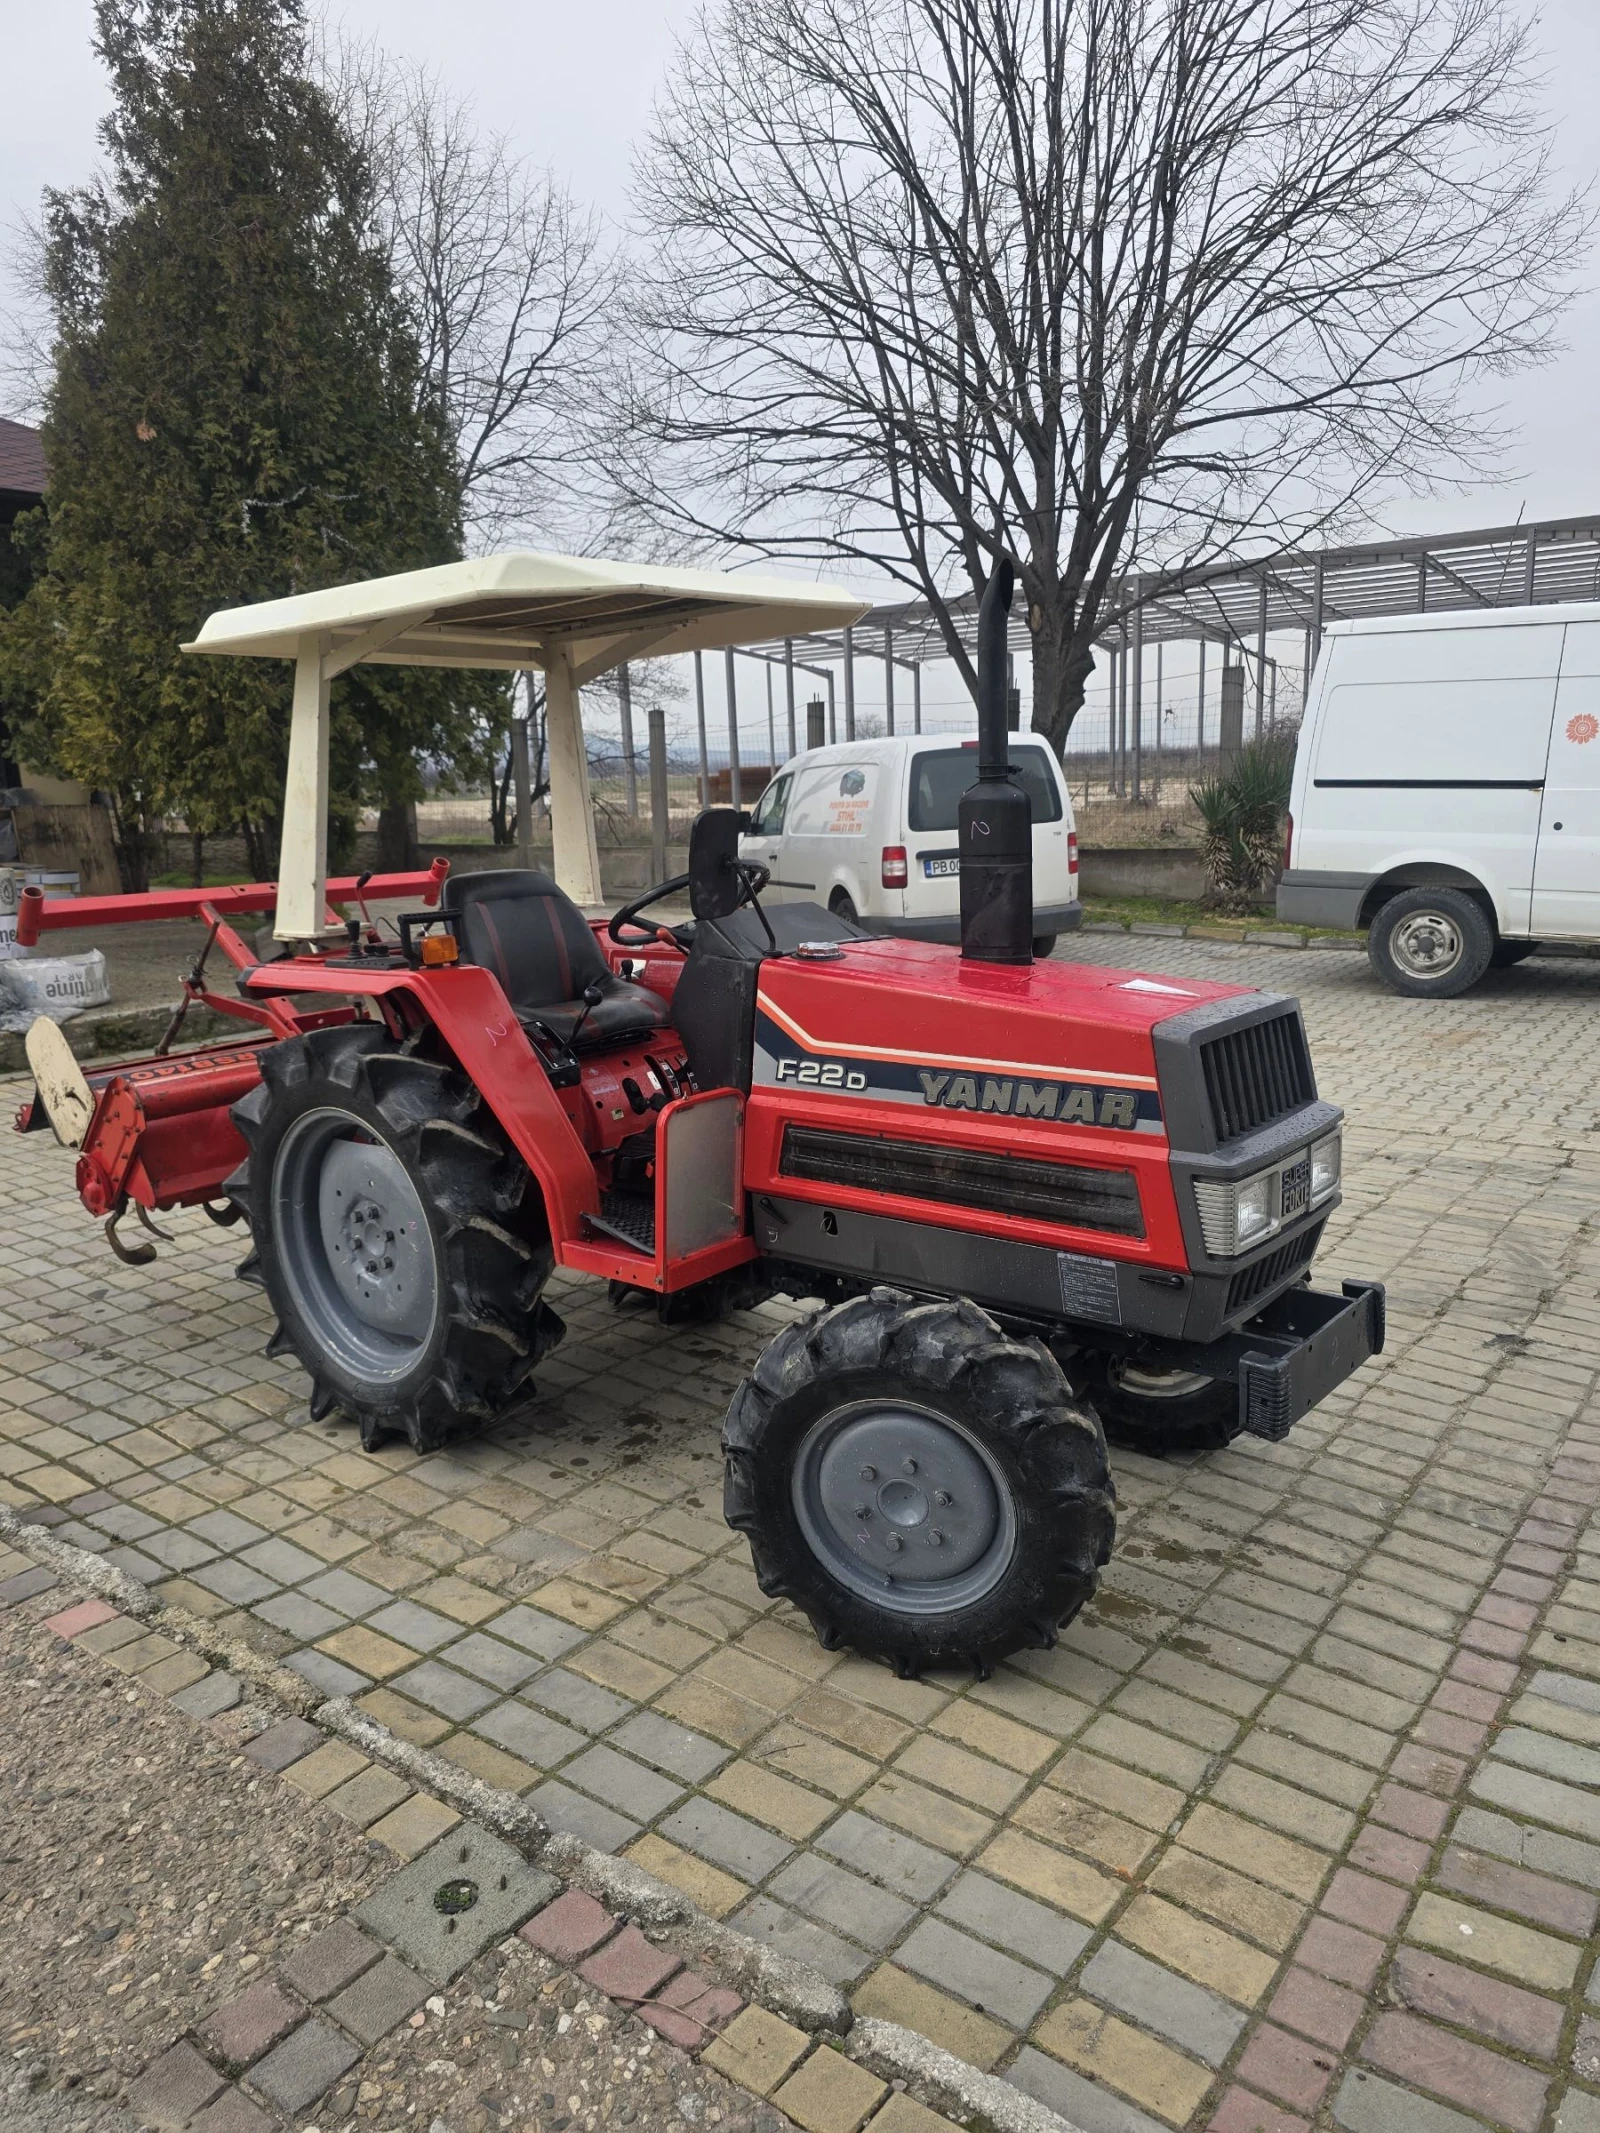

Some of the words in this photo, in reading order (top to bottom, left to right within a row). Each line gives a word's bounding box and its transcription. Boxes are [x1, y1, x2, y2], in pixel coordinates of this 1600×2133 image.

[932, 861, 948, 873] PB
[776, 1058, 868, 1091] F22D
[919, 1072, 1138, 1128] YANMAR
[1282, 1160, 1310, 1189] SUPER
[1282, 1180, 1310, 1215] FORTE
